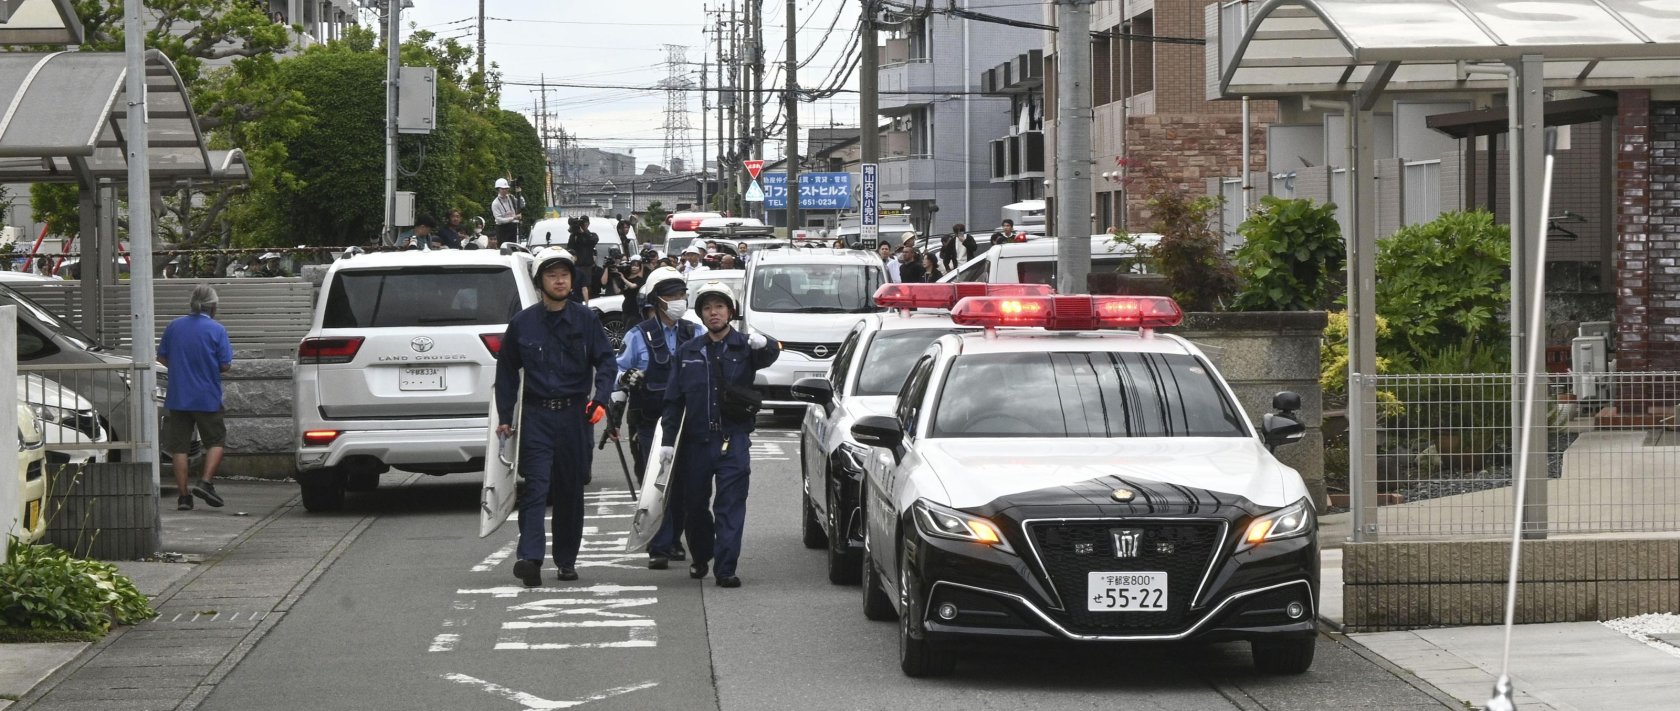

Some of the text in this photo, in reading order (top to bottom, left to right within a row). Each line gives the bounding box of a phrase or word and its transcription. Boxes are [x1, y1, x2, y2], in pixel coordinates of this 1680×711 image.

[773, 185, 848, 196] フストヒルズ
[864, 166, 874, 225] 増山内科小児科
[785, 198, 837, 206] -651-0234
[1093, 588, 1163, 608] せ 55-22
